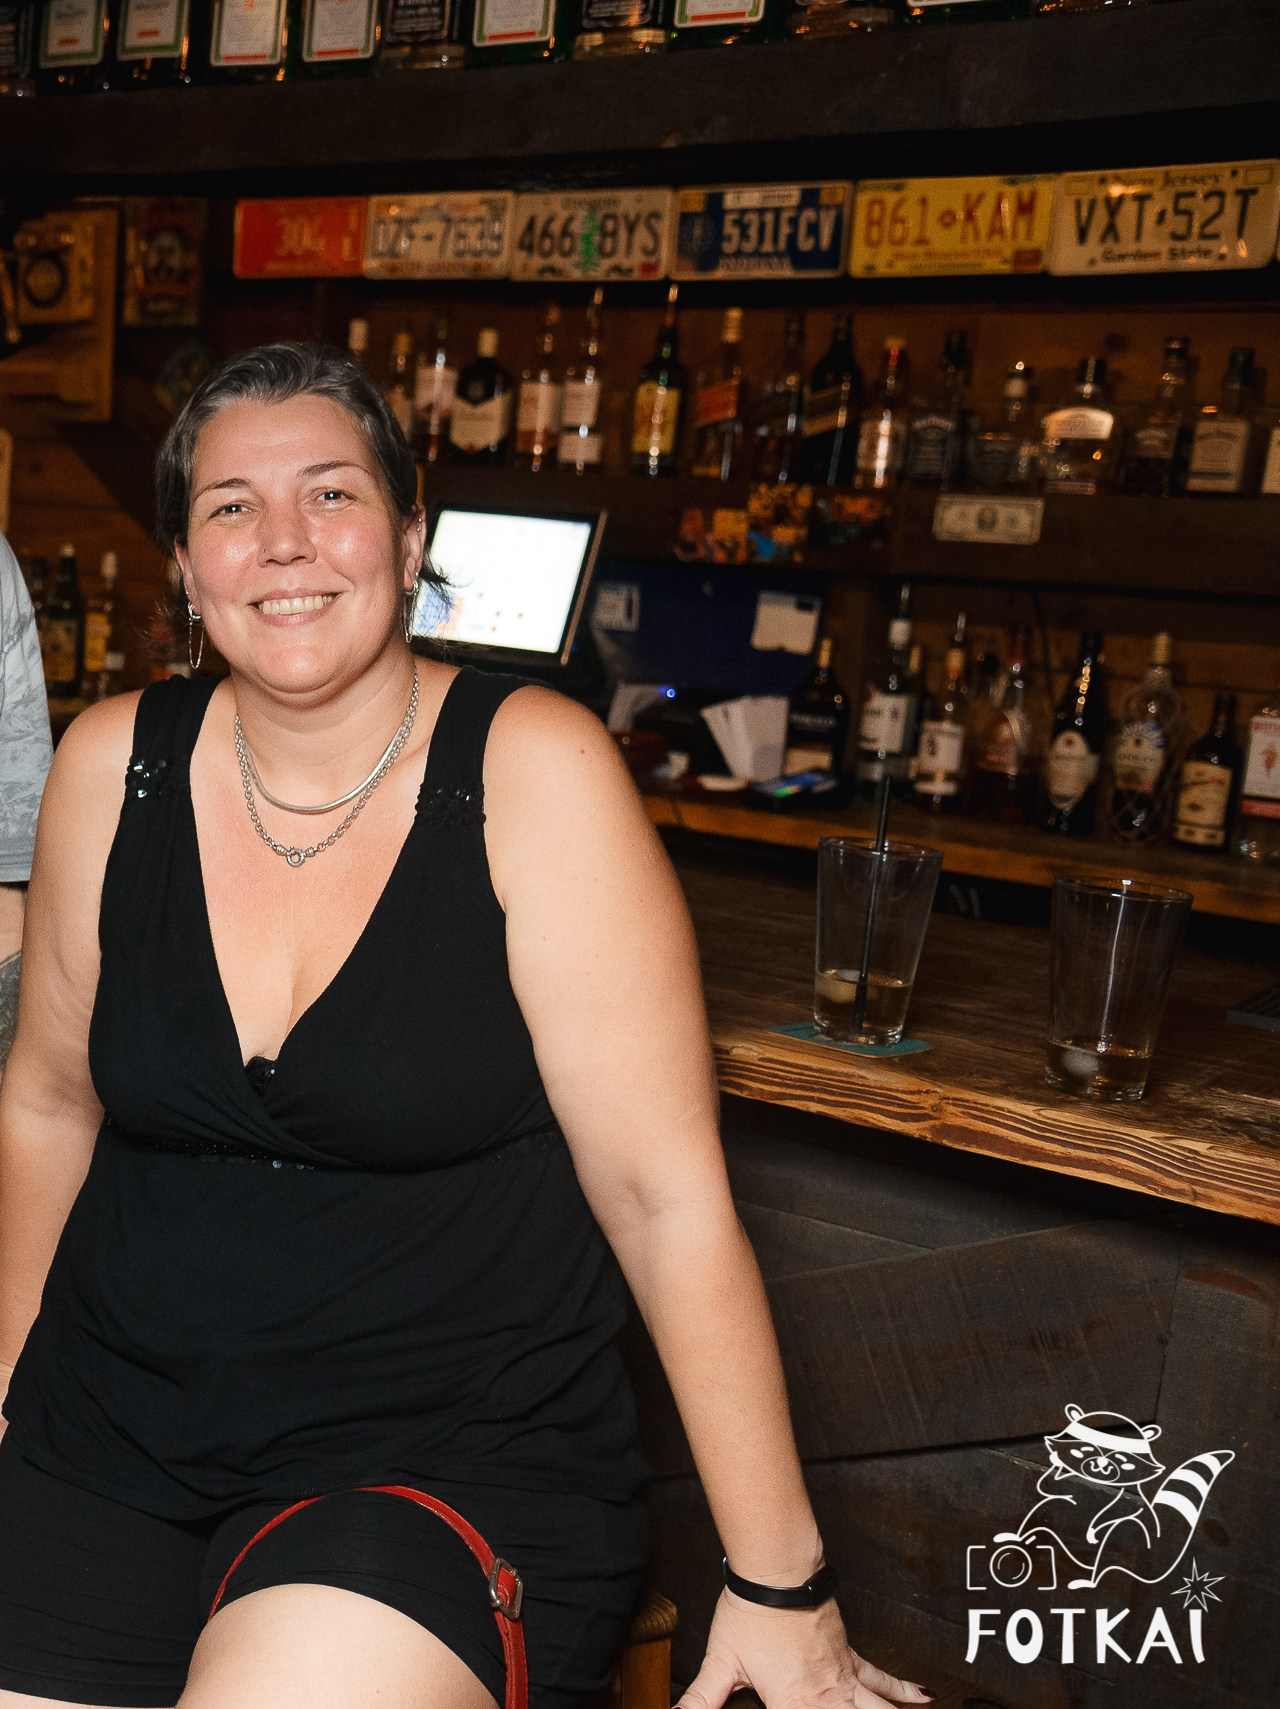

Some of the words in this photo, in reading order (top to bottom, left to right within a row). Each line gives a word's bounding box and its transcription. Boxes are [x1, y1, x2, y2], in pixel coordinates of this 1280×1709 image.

[516, 211, 578, 259] 466
[720, 206, 839, 255] 531FCV
[959, 188, 1039, 245] KAM
[1073, 192, 1155, 247] VXT
[1169, 187, 1260, 242] 52T
